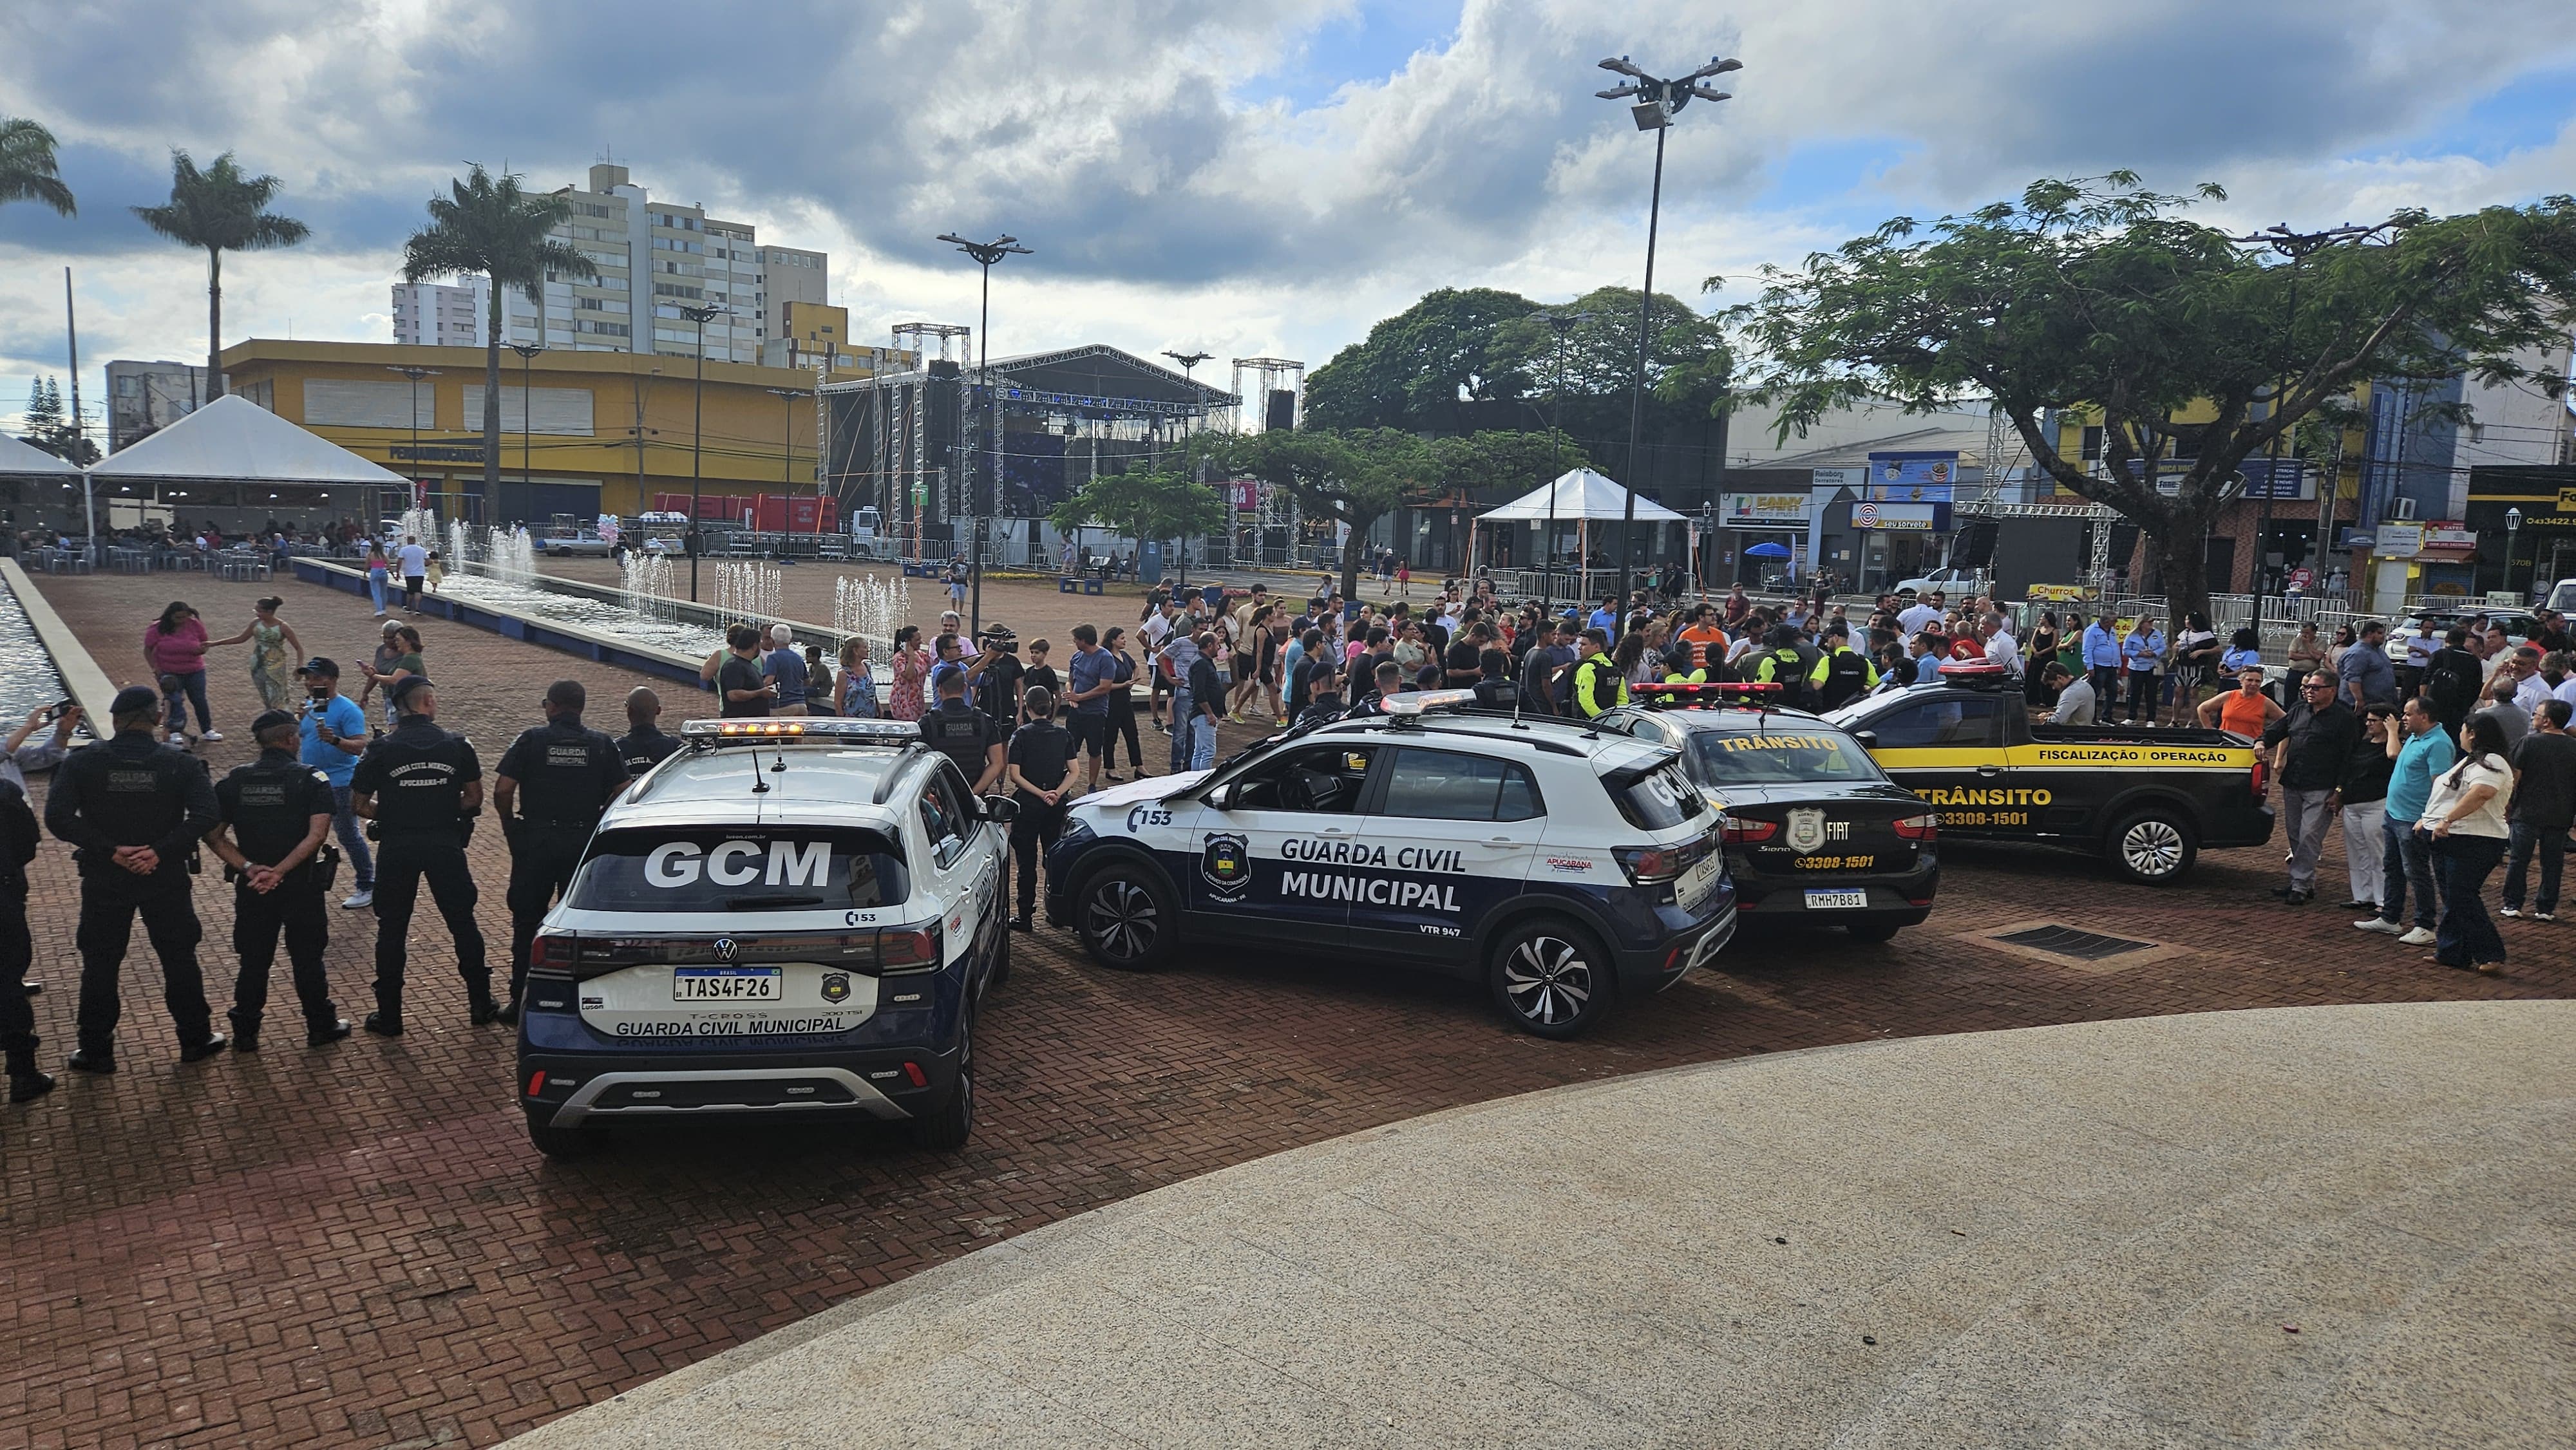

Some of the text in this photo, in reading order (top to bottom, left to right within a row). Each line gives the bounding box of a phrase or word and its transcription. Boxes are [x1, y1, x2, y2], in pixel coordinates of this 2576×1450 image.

[2038, 586, 2074, 596] Churros
[946, 722, 972, 731] GUARDA
[1718, 734, 1839, 752] TRÂNSITO
[549, 747, 587, 757] GUARDA
[2040, 749, 2139, 762] FISCALIZAÇÃO
[2150, 751, 2227, 764] OPERAÇÃO
[549, 757, 587, 765] MUNICIPAL
[109, 772, 153, 782] GUARDA
[390, 762, 456, 778] GUARDA CIVIL MUNICIPAL
[242, 786, 283, 794] GUARDA
[1645, 763, 1696, 807] GCM
[1914, 786, 2052, 805] TRÂNSITO
[1141, 811, 1173, 825] 153
[1945, 812, 2028, 825] 3308-1501
[1826, 822, 1850, 840] FIAT
[1206, 837, 1220, 847] GUARDA
[1229, 836, 1245, 850] MUNICIPAL
[1280, 838, 1466, 872] GUARDA CIVIL
[1805, 855, 1874, 869] 3308-1501
[644, 840, 832, 888] GCM
[1547, 858, 1593, 868] APUCARANA
[1208, 893, 1237, 903] APUCARANA
[1280, 871, 1461, 912] MUNICIPAL
[1811, 894, 1861, 907] RMH7B81
[853, 914, 876, 922] 153
[1419, 924, 1461, 937] VTR 947
[685, 978, 770, 997] TAS4F26
[616, 1017, 846, 1035] GUARDA CIVIL MUNICIPAL
